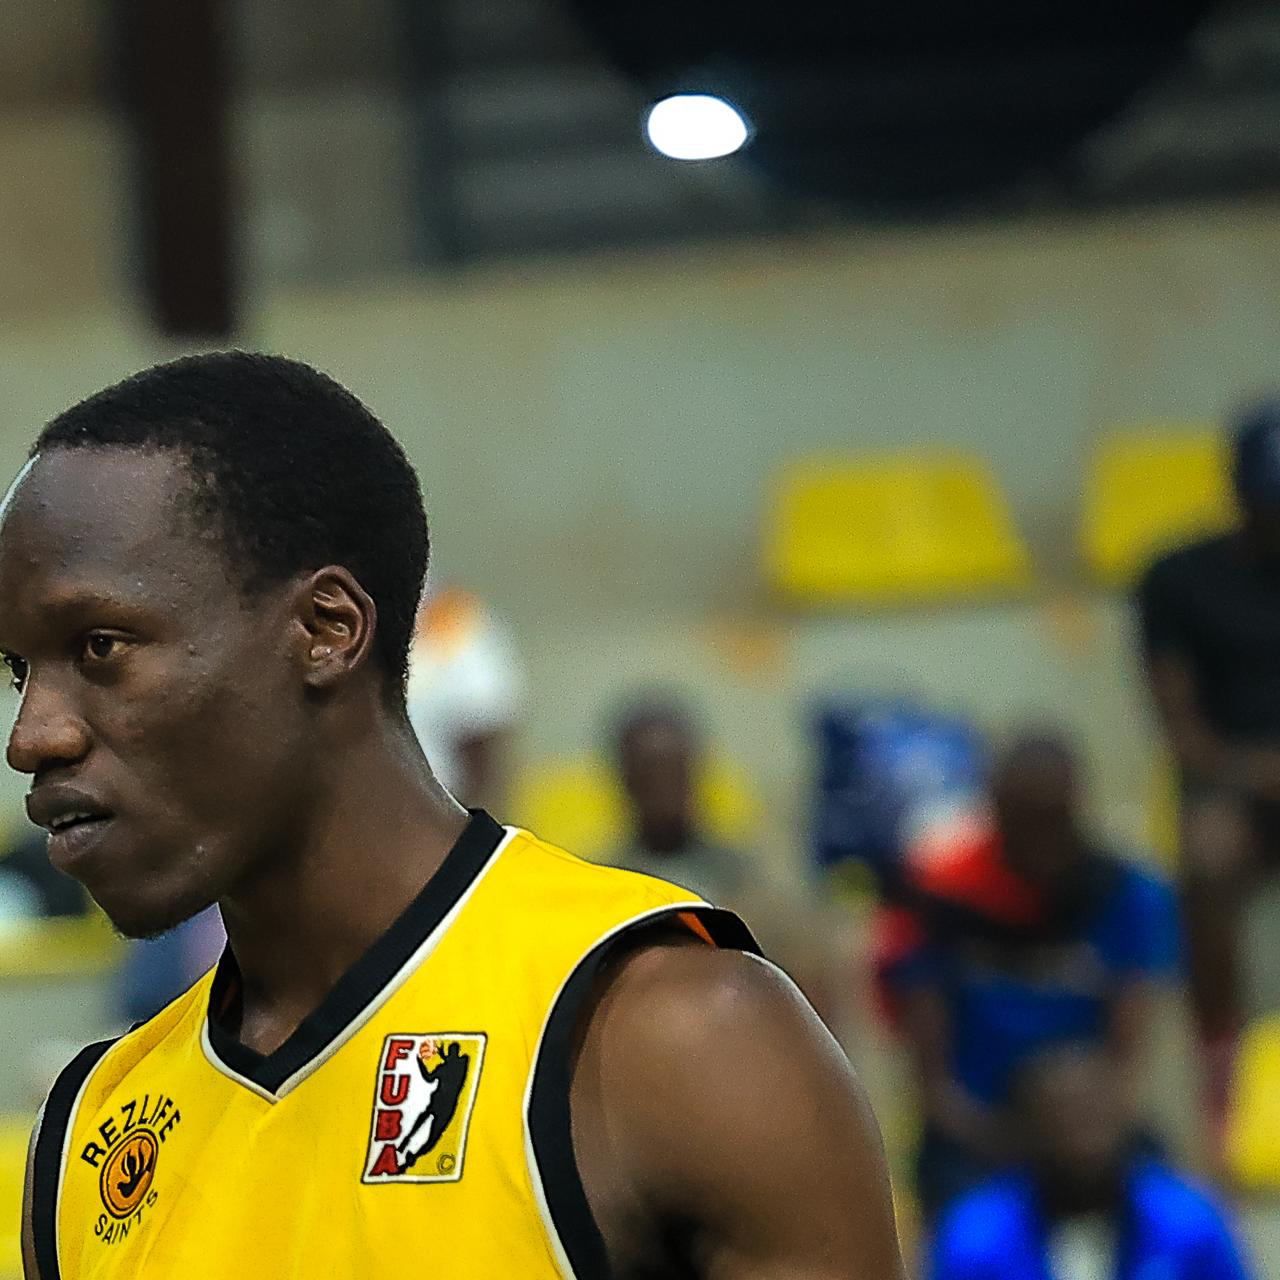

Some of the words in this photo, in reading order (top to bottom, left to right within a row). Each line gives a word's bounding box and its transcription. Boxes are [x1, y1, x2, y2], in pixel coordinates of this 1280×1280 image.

[80, 1094, 181, 1168] REZLIFE
[368, 1039, 415, 1176] FUBA
[94, 1188, 159, 1245] SAINTS
